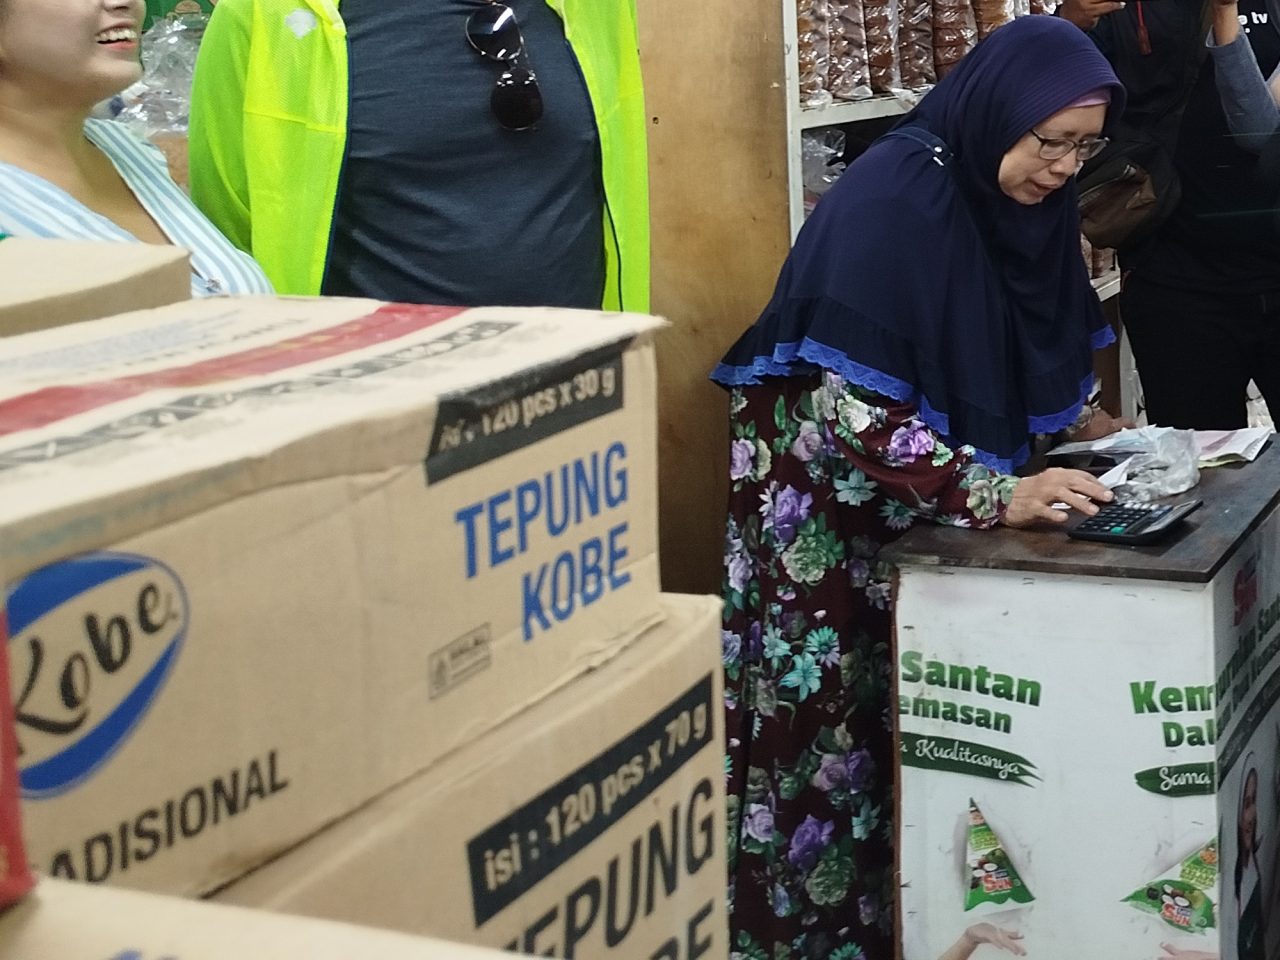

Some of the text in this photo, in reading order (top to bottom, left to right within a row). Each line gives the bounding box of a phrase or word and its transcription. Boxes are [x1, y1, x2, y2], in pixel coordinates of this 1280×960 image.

[1251, 11, 1268, 24] tv
[521, 386, 558, 428] pcs
[559, 383, 574, 407] x
[573, 367, 600, 401] 30
[601, 366, 616, 398] g
[454, 440, 629, 580] TEPUNG
[521, 521, 633, 645] KOBE
[900, 649, 1042, 708] Santan
[545, 782, 597, 846] 120
[601, 754, 646, 817] pcs
[648, 738, 663, 775] x
[664, 709, 692, 759] 70
[693, 702, 708, 741] g
[915, 739, 1021, 780] Kualitasnya
[1159, 766, 1212, 791] Sama
[503, 775, 715, 960] EPUNG
